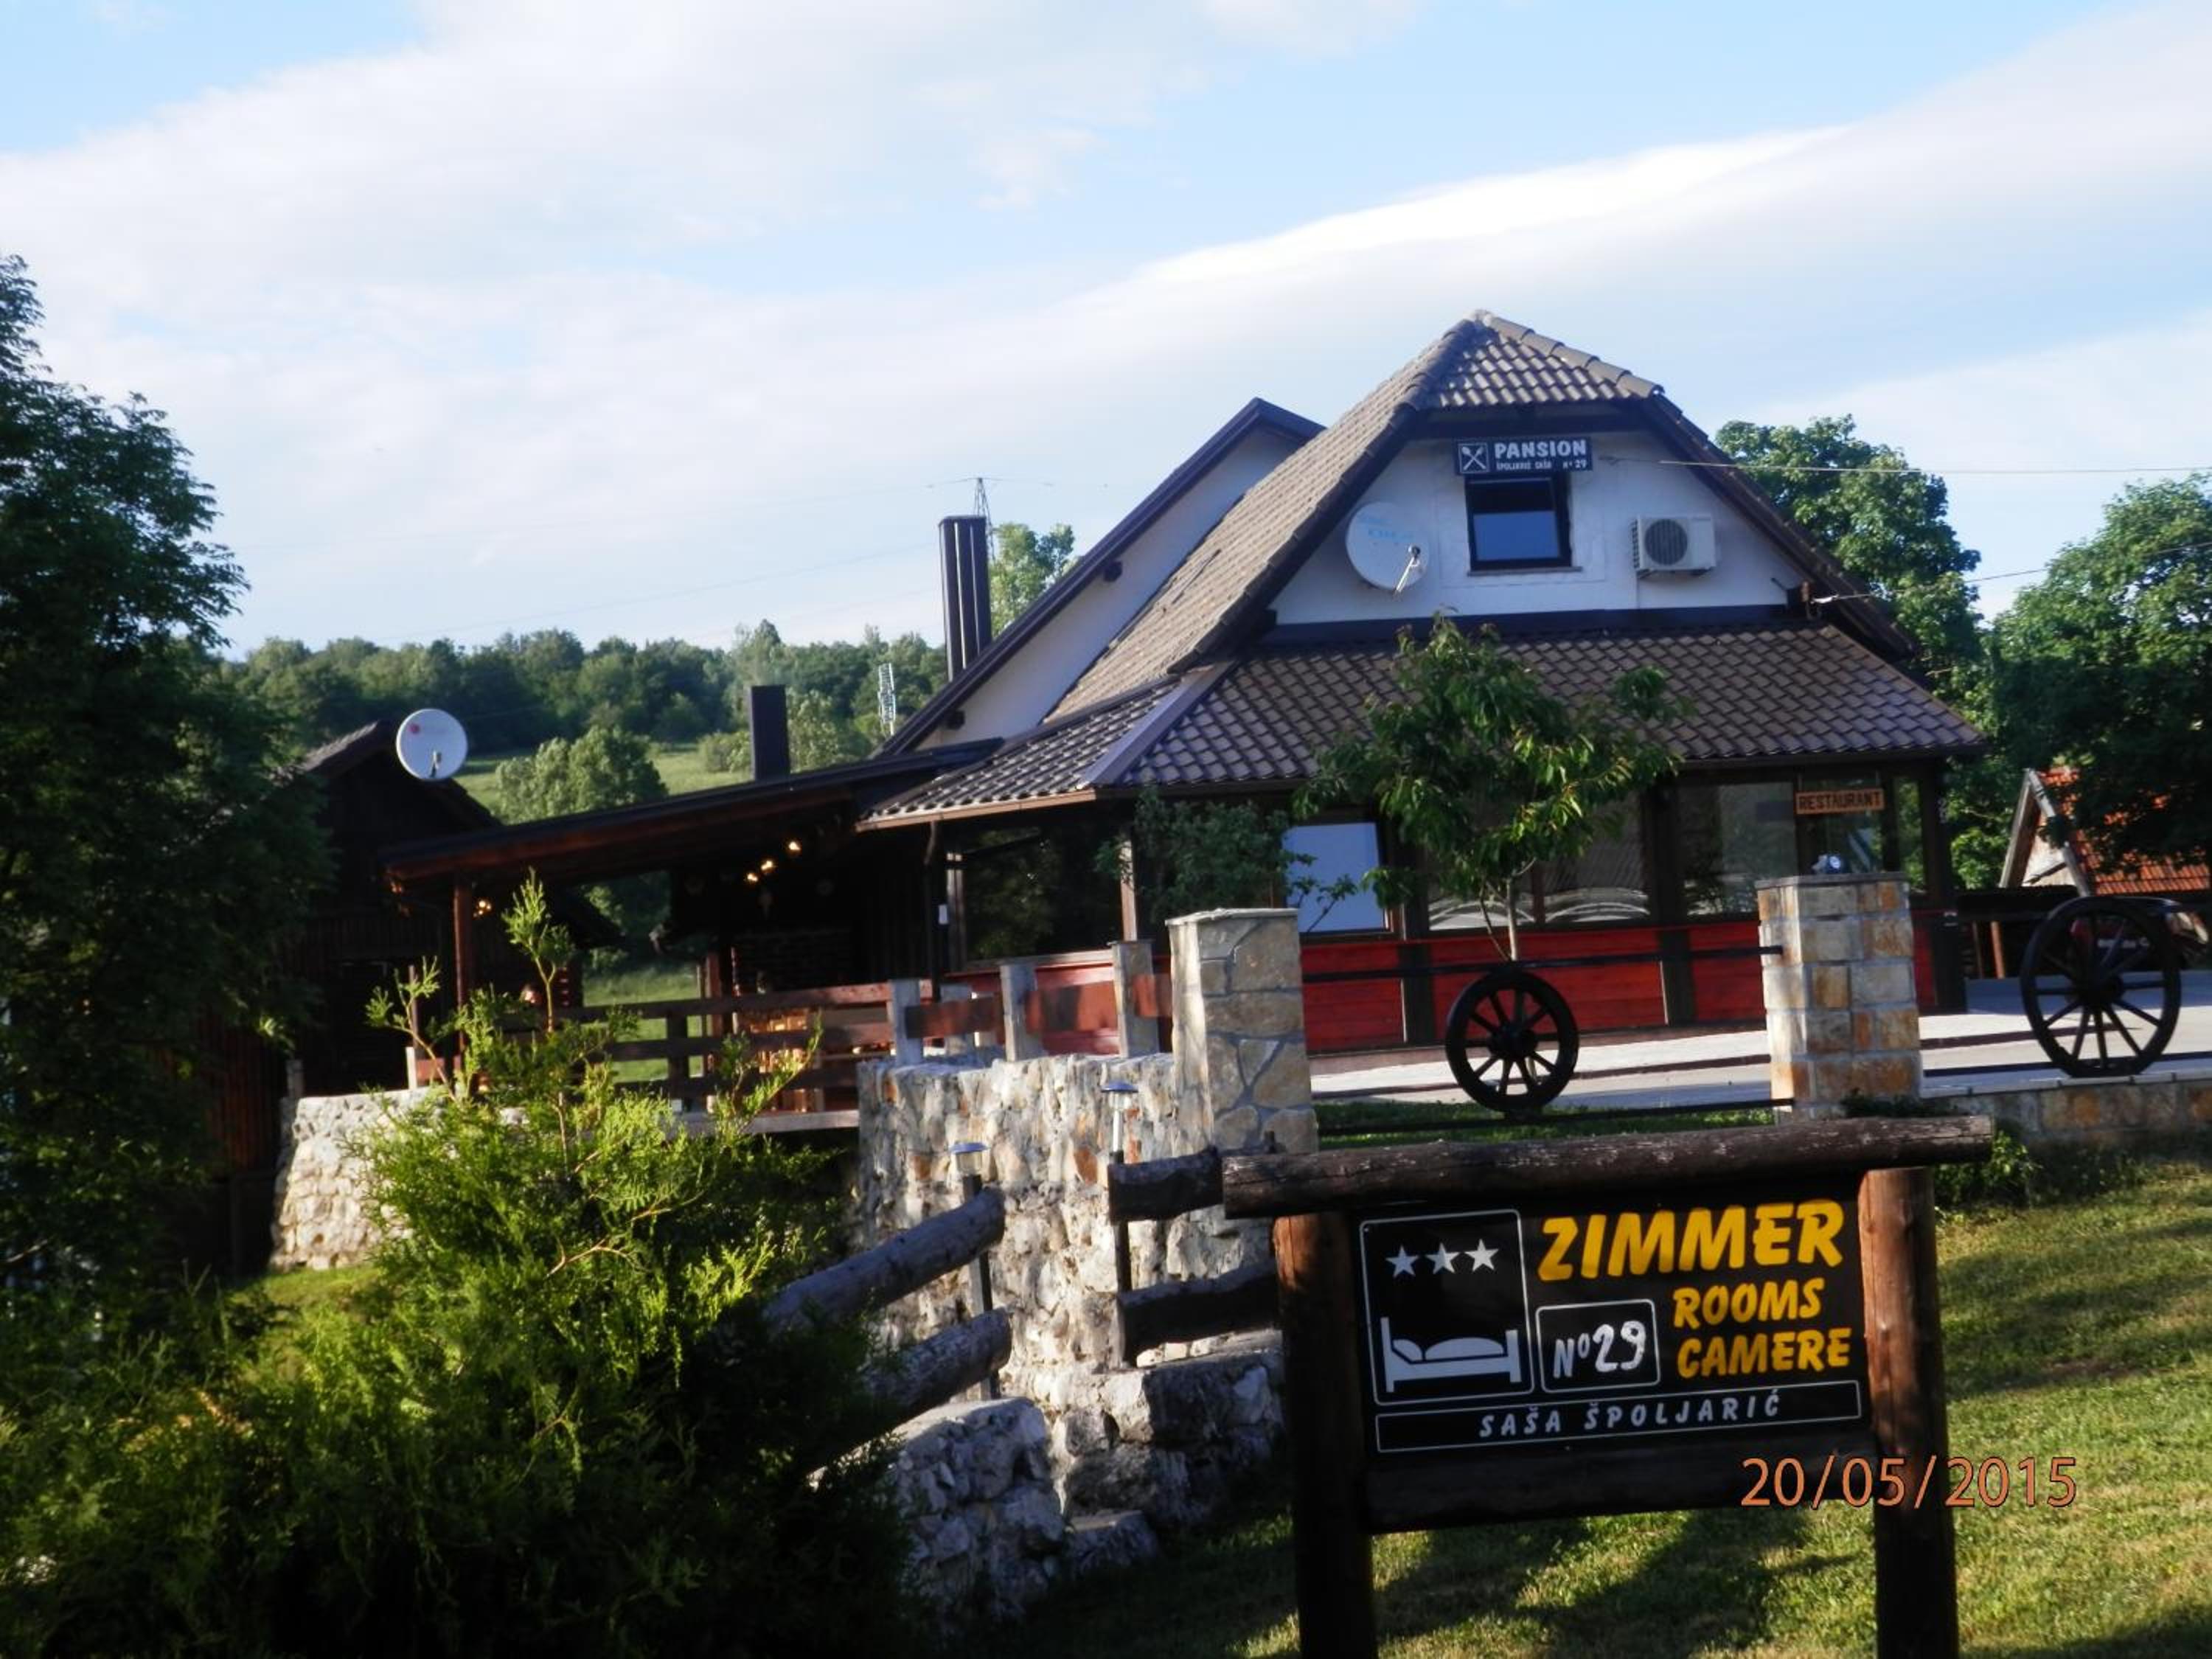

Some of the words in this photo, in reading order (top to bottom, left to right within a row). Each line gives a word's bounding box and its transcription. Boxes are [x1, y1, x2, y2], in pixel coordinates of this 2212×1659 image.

[1495, 439, 1587, 459] PANSION
[1798, 790, 1879, 811] RESTAURANT
[1537, 1200, 1844, 1282] ZIMMER
[1673, 1277, 1826, 1329] ROOMS
[1677, 1328, 1853, 1378] CAMERE
[1478, 1405, 1562, 1438] SAŠA
[1583, 1389, 1781, 1430] ŠPOLJARIĆ
